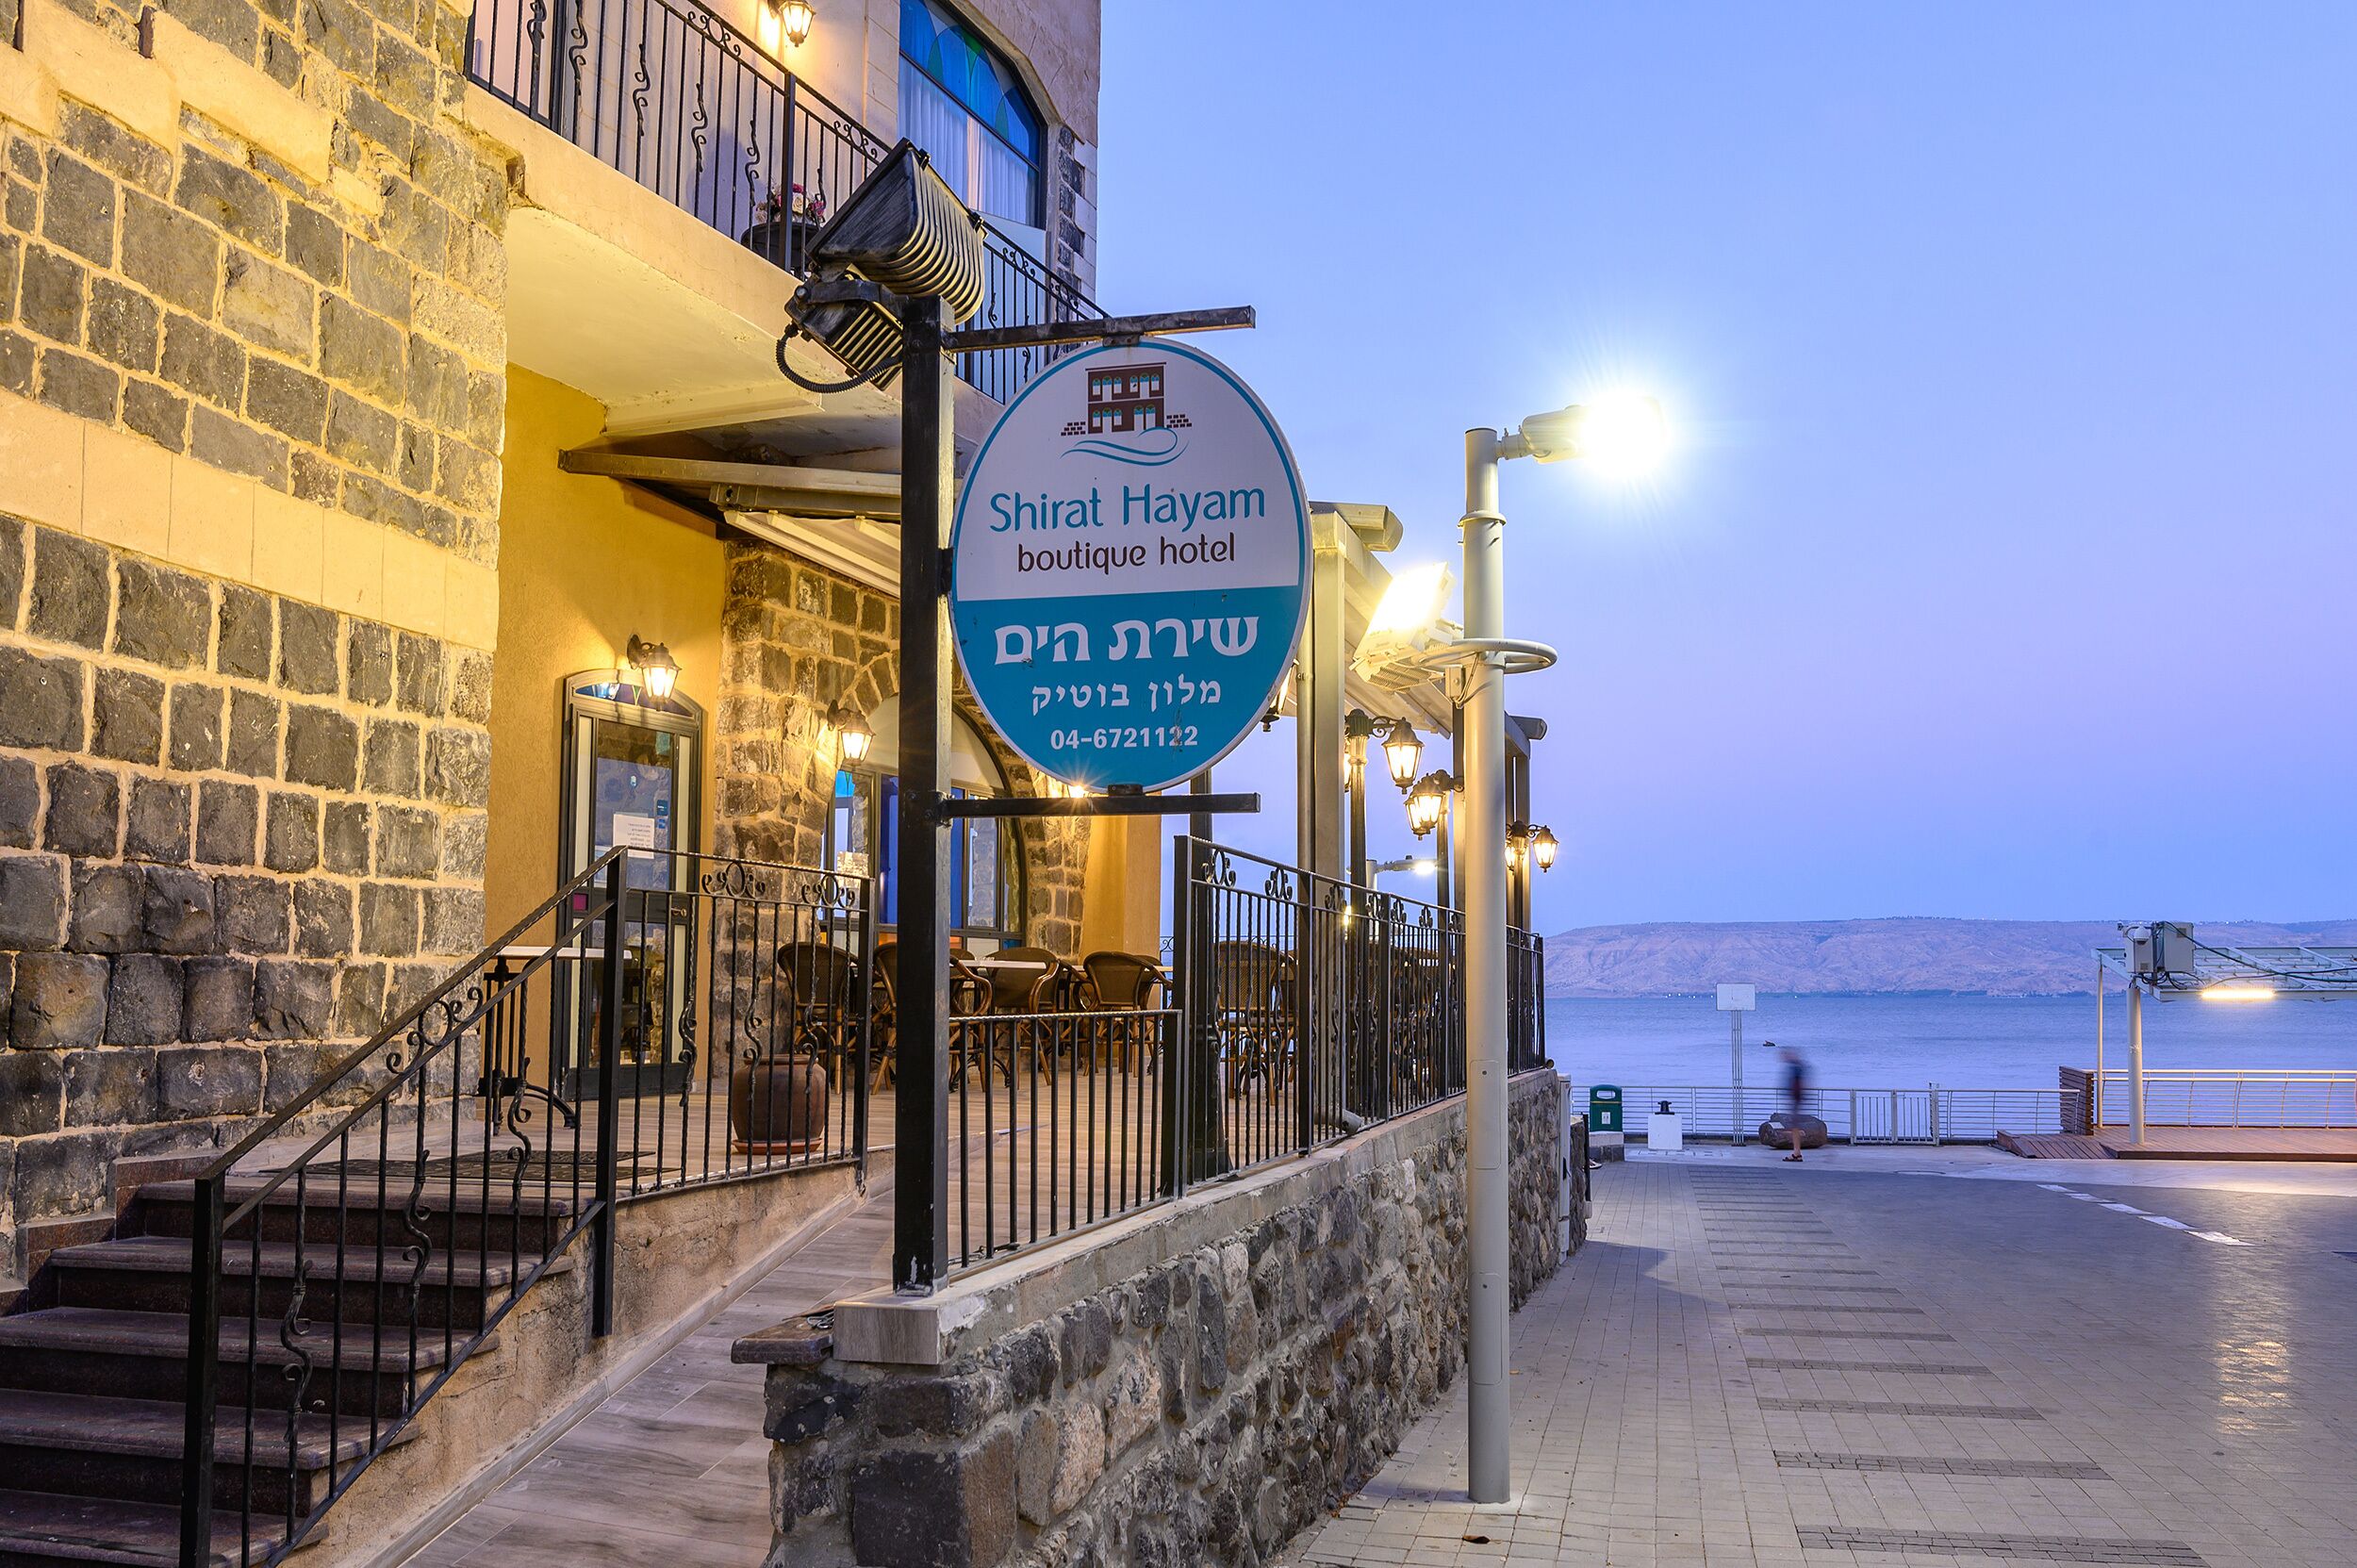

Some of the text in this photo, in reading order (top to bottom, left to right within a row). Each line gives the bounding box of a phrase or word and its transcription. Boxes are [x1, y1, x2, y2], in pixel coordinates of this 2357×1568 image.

[990, 483, 1264, 532] Shirat Hayam
[1018, 533, 1235, 574] boutique hotel
[996, 616, 1260, 665] שירת הים
[1032, 674, 1222, 716] מלון בוטיק
[1051, 726, 1198, 750] 04-6721122
